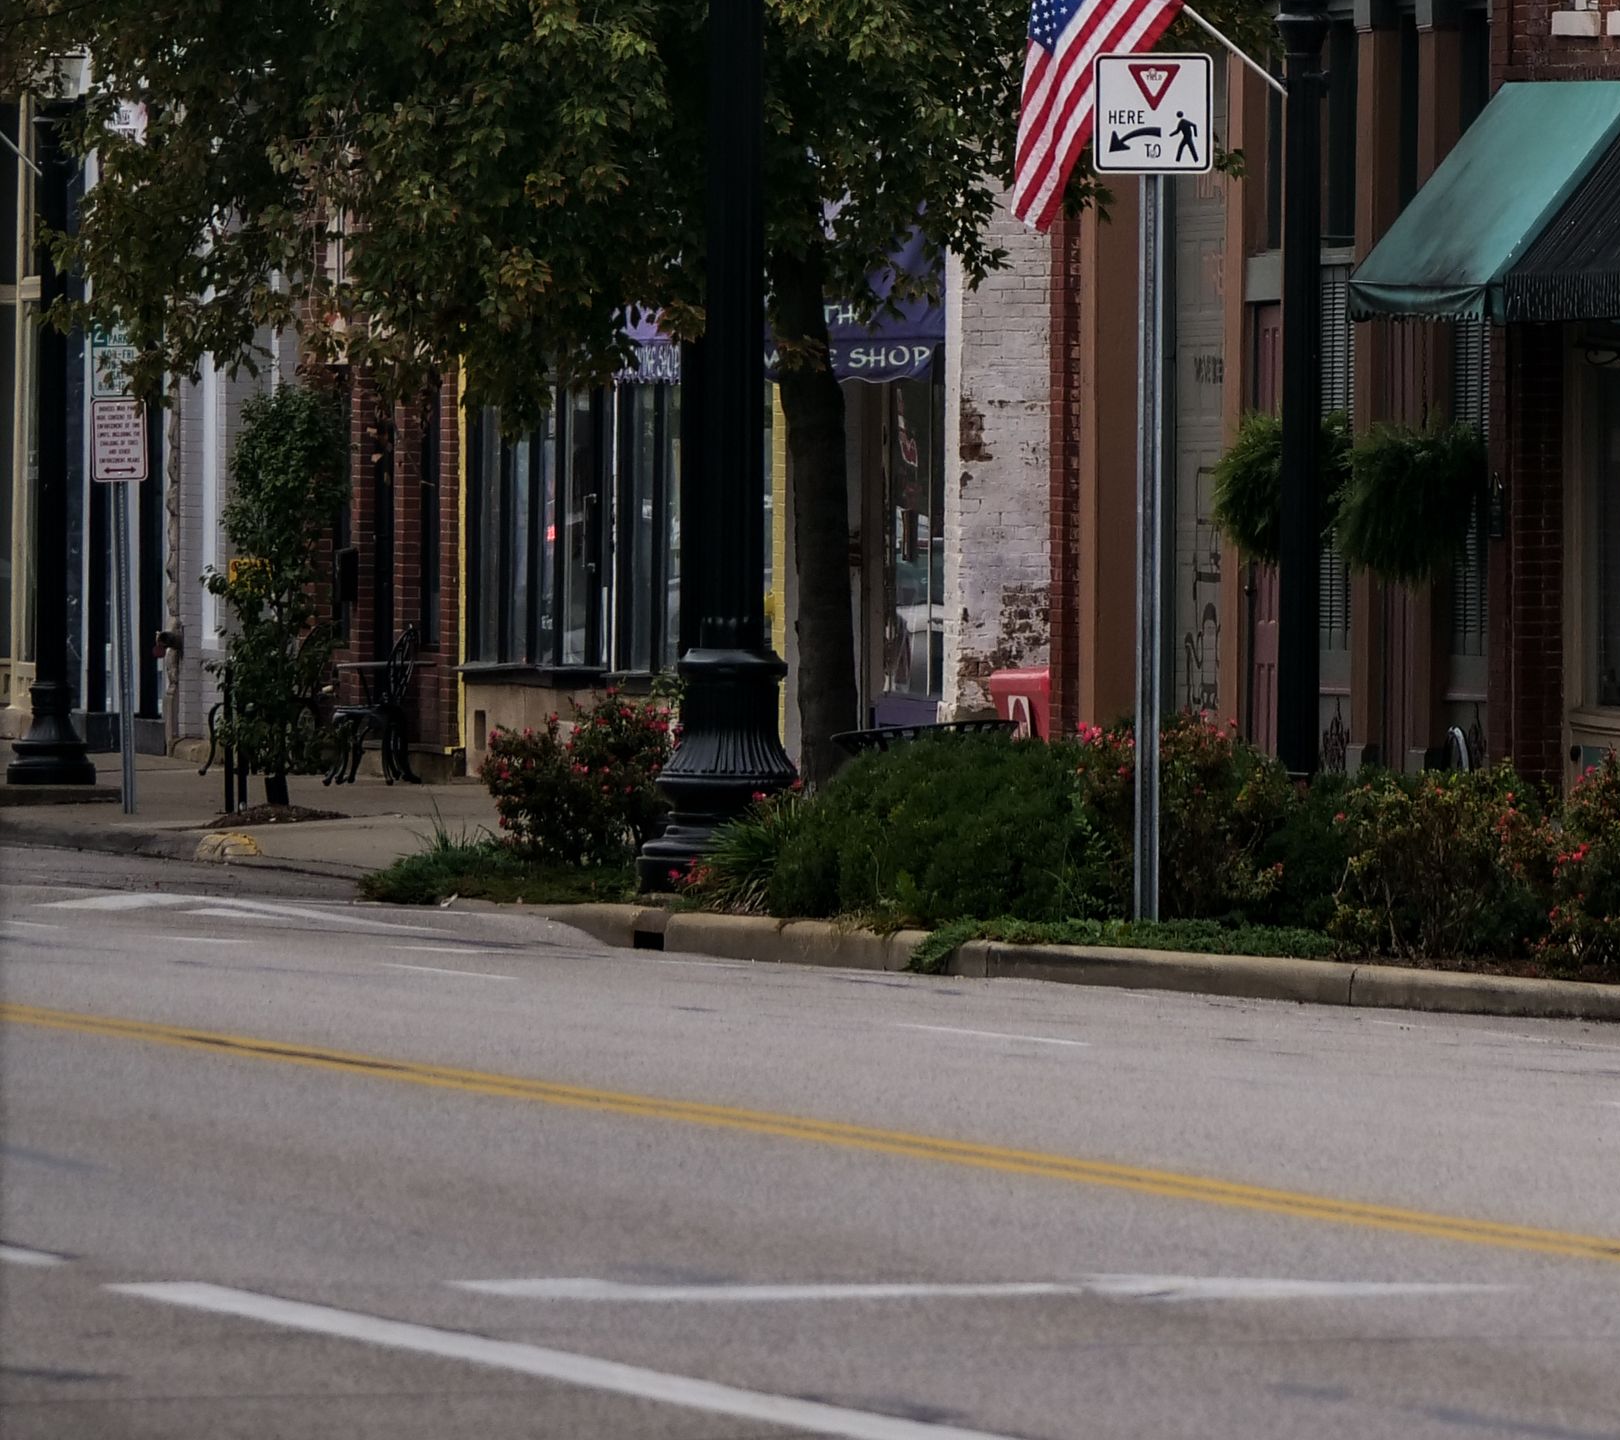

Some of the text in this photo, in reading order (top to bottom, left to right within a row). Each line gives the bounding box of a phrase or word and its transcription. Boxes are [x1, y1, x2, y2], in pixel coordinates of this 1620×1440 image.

[1108, 109, 1145, 125] HERE
[1144, 143, 1161, 159] TO
[848, 345, 930, 369] SHOP
